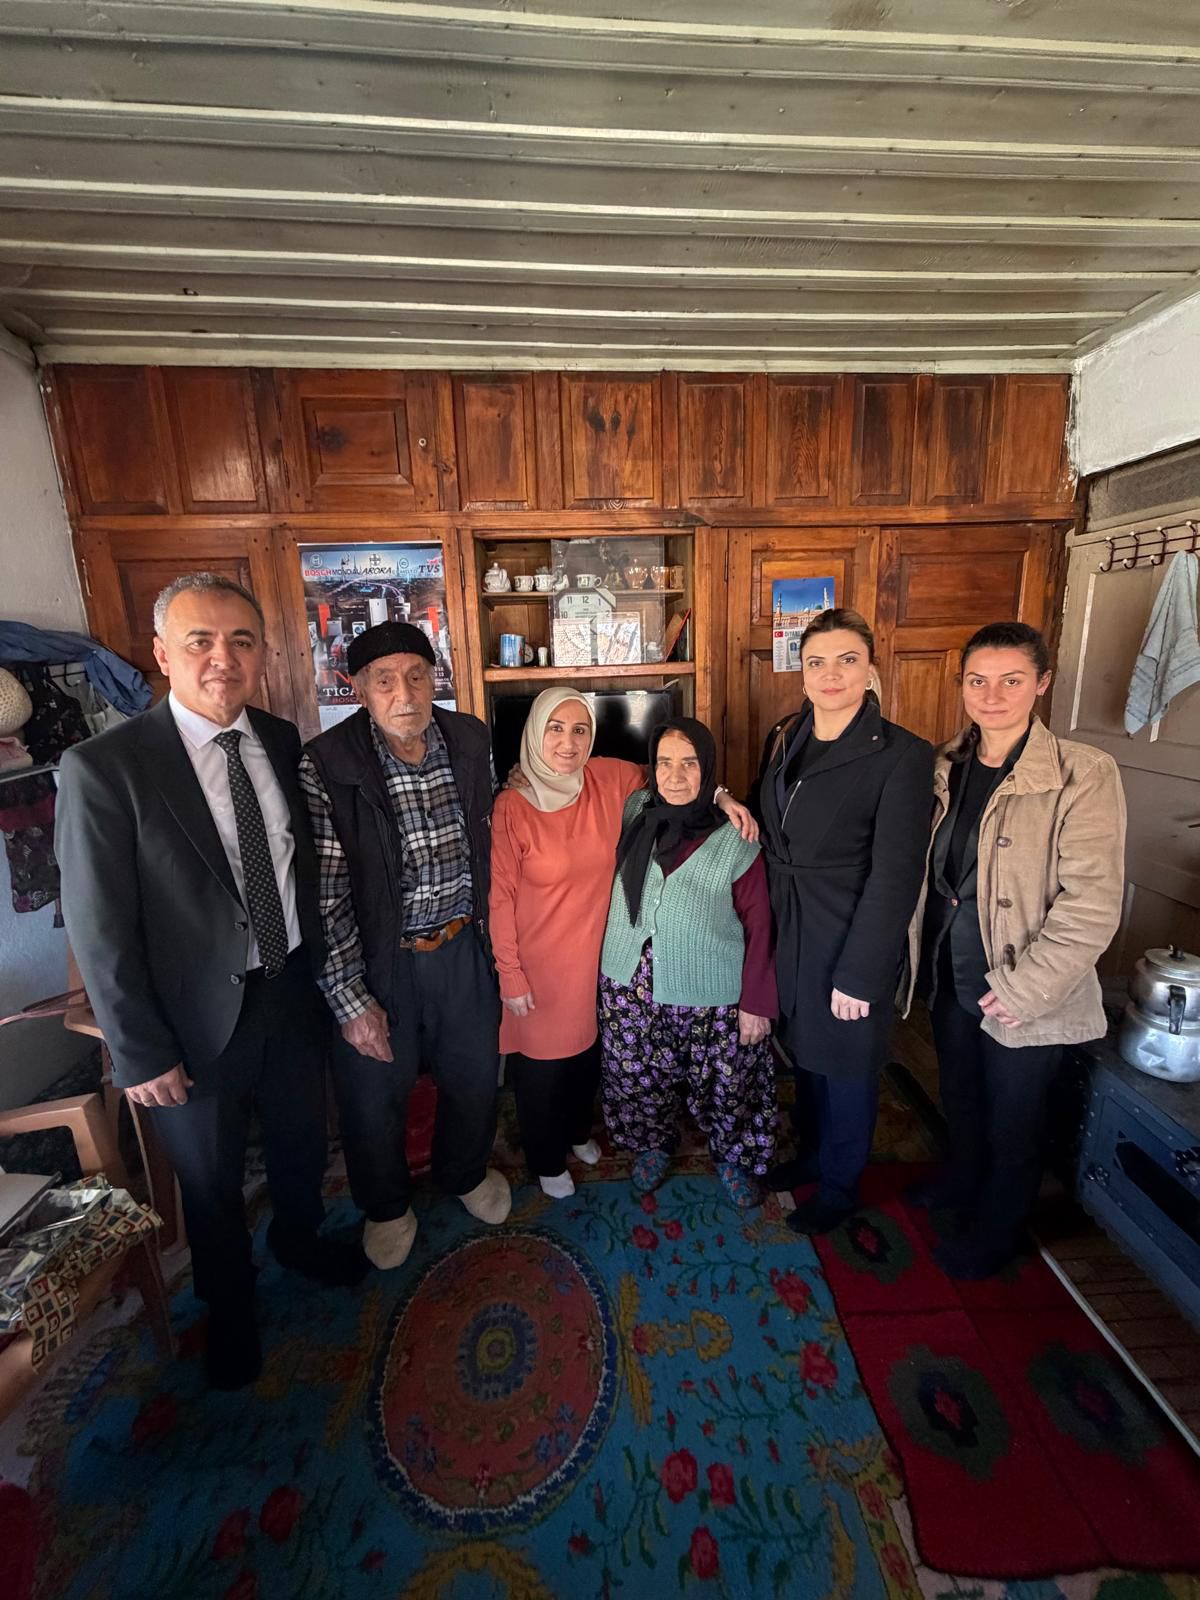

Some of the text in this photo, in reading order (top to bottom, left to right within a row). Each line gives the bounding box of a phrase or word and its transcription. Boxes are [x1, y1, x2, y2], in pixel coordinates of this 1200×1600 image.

[304, 568, 332, 577] BOSCH
[362, 567, 392, 575] ARORA
[418, 564, 441, 573] TVS
[567, 596, 572, 604] 11
[582, 595, 590, 604] 12
